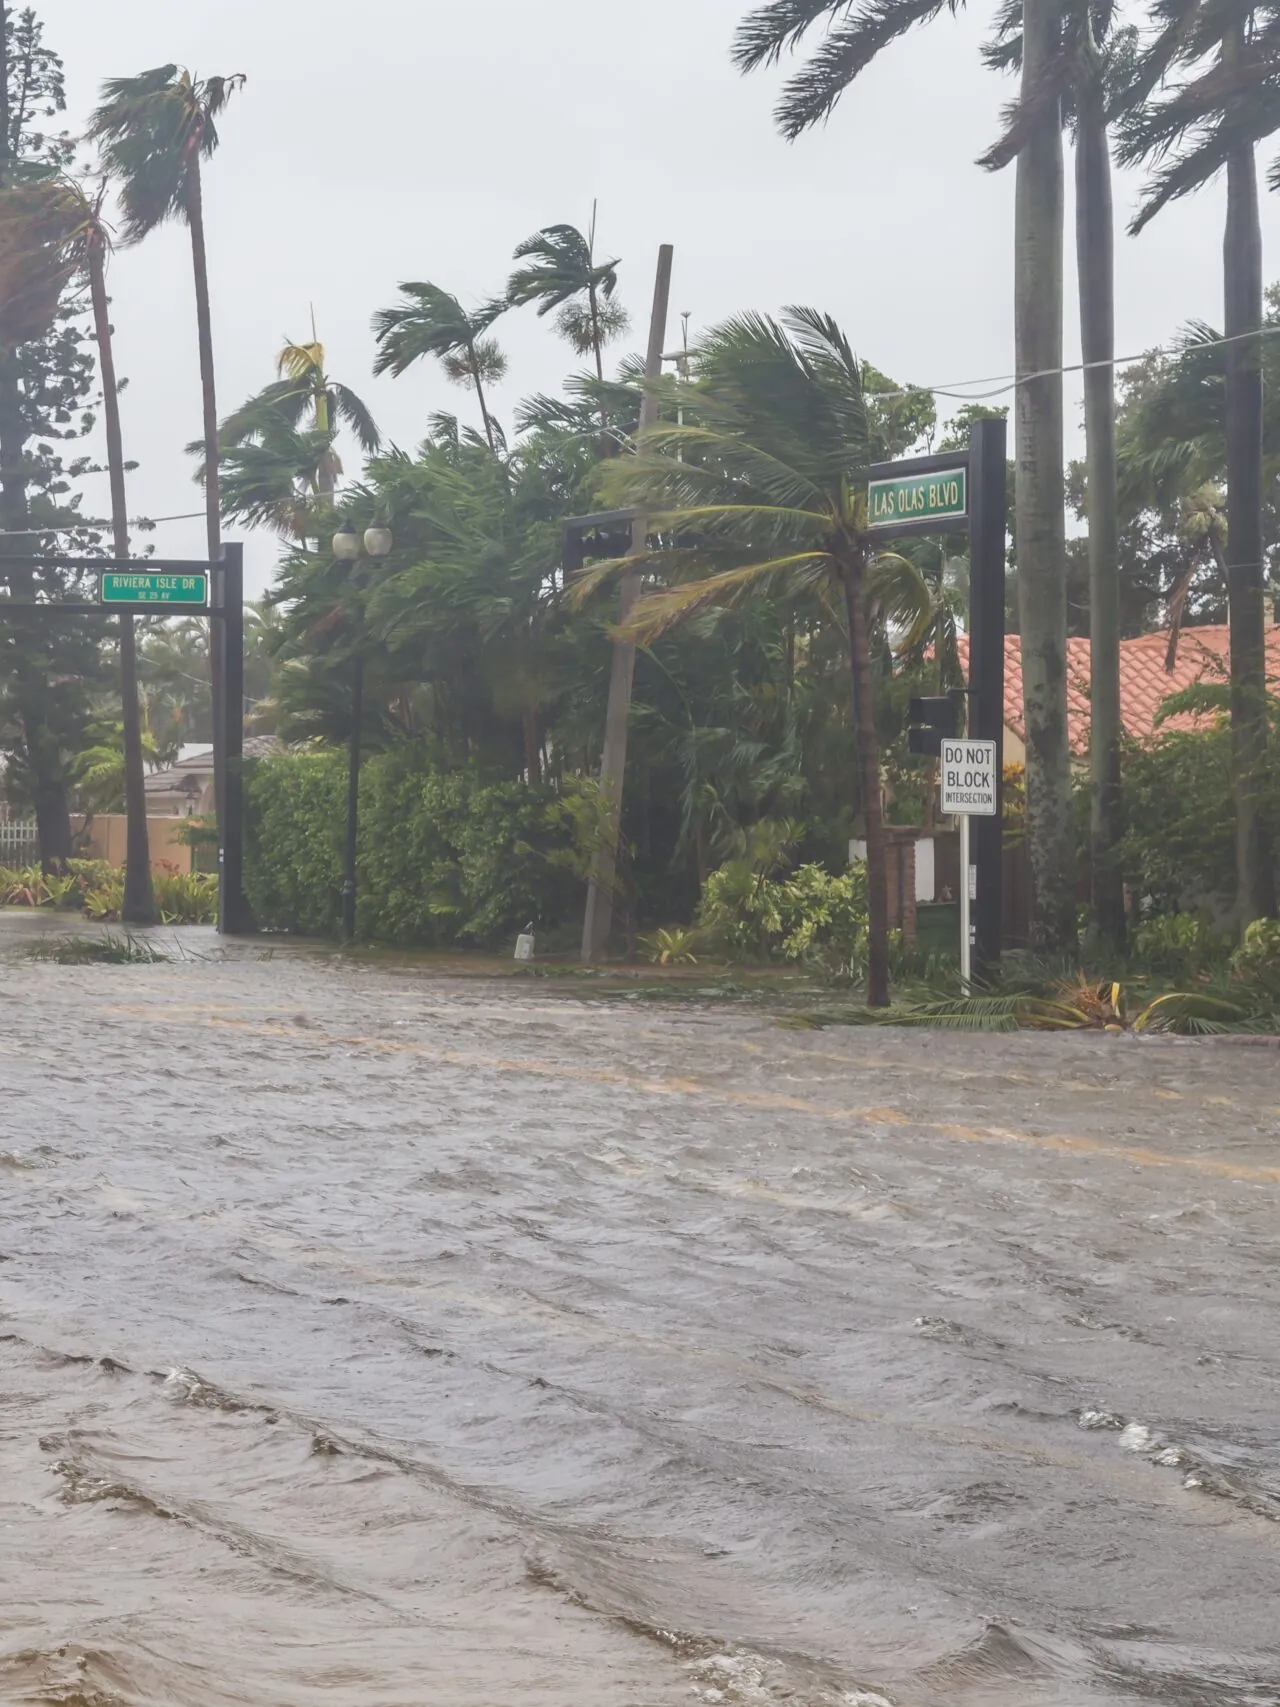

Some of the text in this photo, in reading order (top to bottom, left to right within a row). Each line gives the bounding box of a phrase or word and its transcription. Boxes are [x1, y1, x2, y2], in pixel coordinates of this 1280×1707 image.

[874, 481, 958, 516] LAS OLAS BLVD
[113, 577, 195, 589] RIVIERA ISLE DR
[945, 747, 992, 765] DO NOT
[947, 771, 990, 788] BLOCK
[945, 792, 992, 804] INTERSECTION
